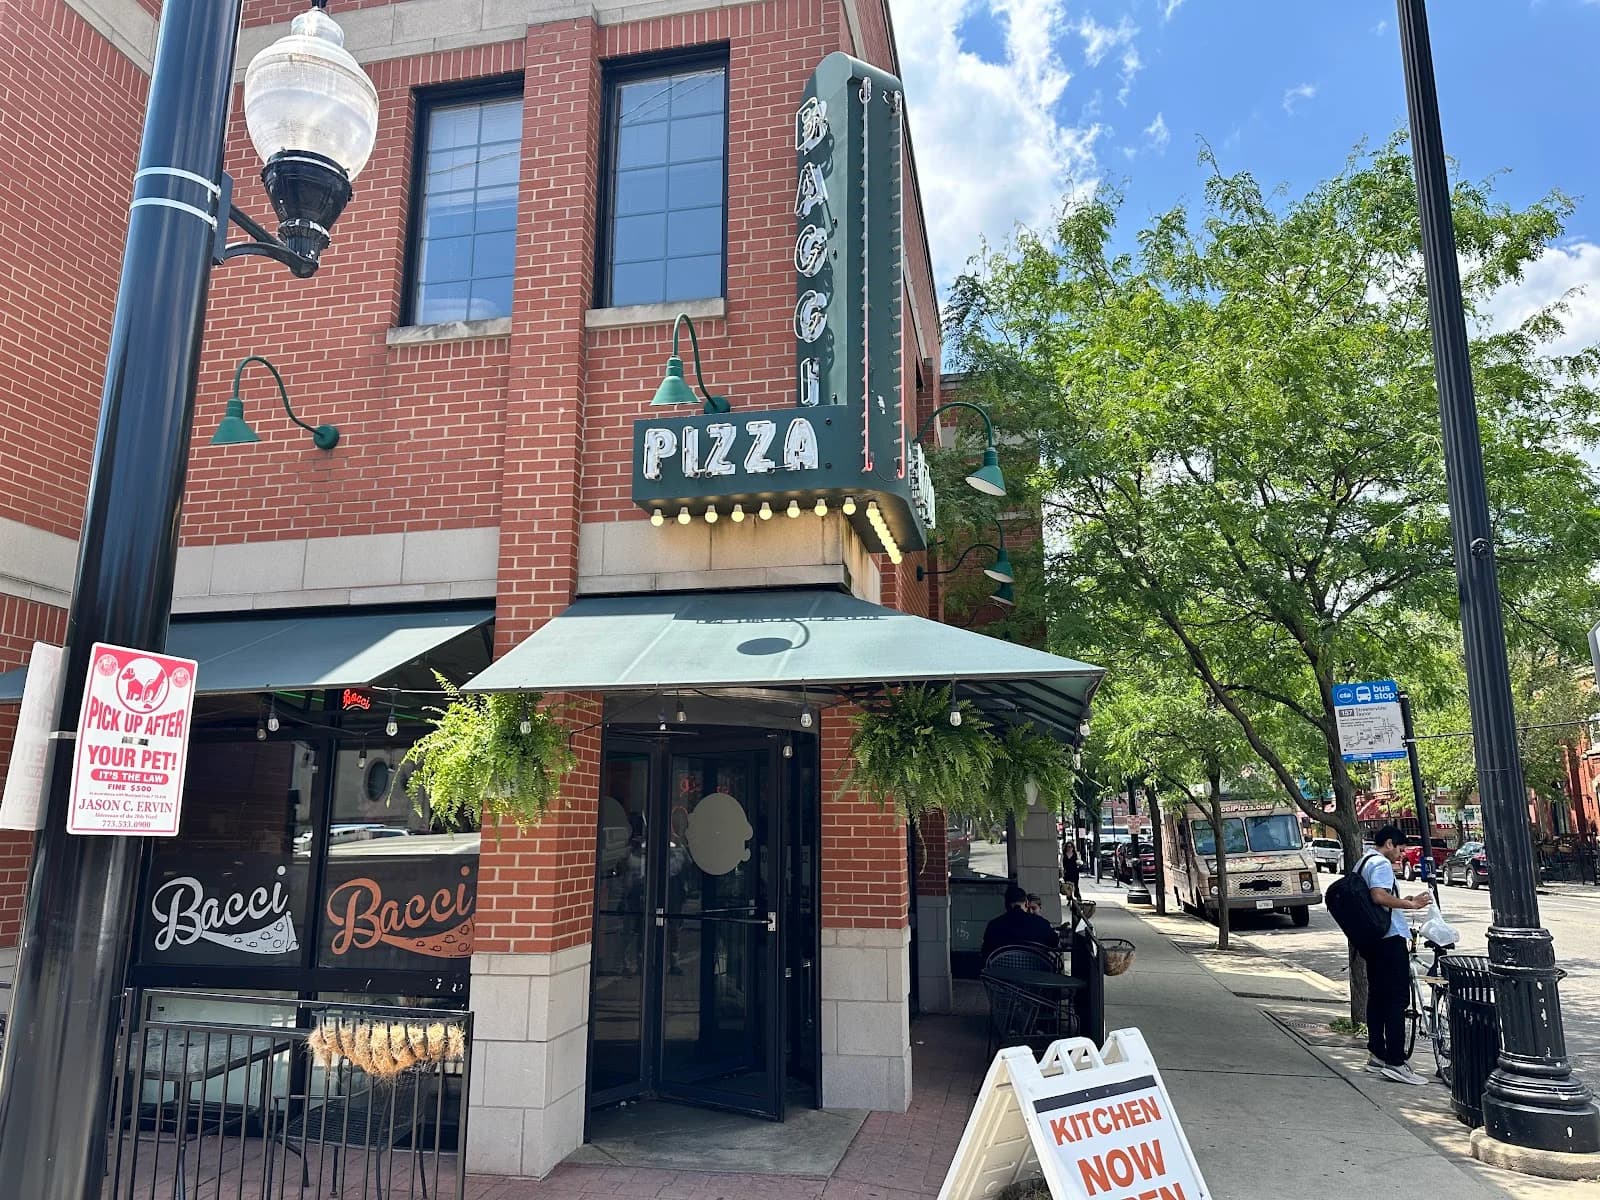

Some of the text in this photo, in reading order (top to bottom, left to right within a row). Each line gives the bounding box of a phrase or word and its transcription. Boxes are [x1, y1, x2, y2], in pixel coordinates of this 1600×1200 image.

[794, 97, 829, 406] BACCI
[643, 418, 819, 481] PIZZA
[342, 689, 370, 709] Bacci
[1373, 684, 1390, 692] bus
[1374, 692, 1395, 700] stop
[87, 696, 185, 738] PICK UP AFTER
[88, 745, 177, 771] YOUR PET!
[98, 771, 163, 783] IT'S THE LAW
[79, 798, 173, 813] JASON C. ERVIN
[151, 865, 289, 951] Bacci
[326, 865, 474, 955] Bacci
[1049, 1096, 1162, 1146] KITCHEN
[1077, 1139, 1166, 1196] NOW
